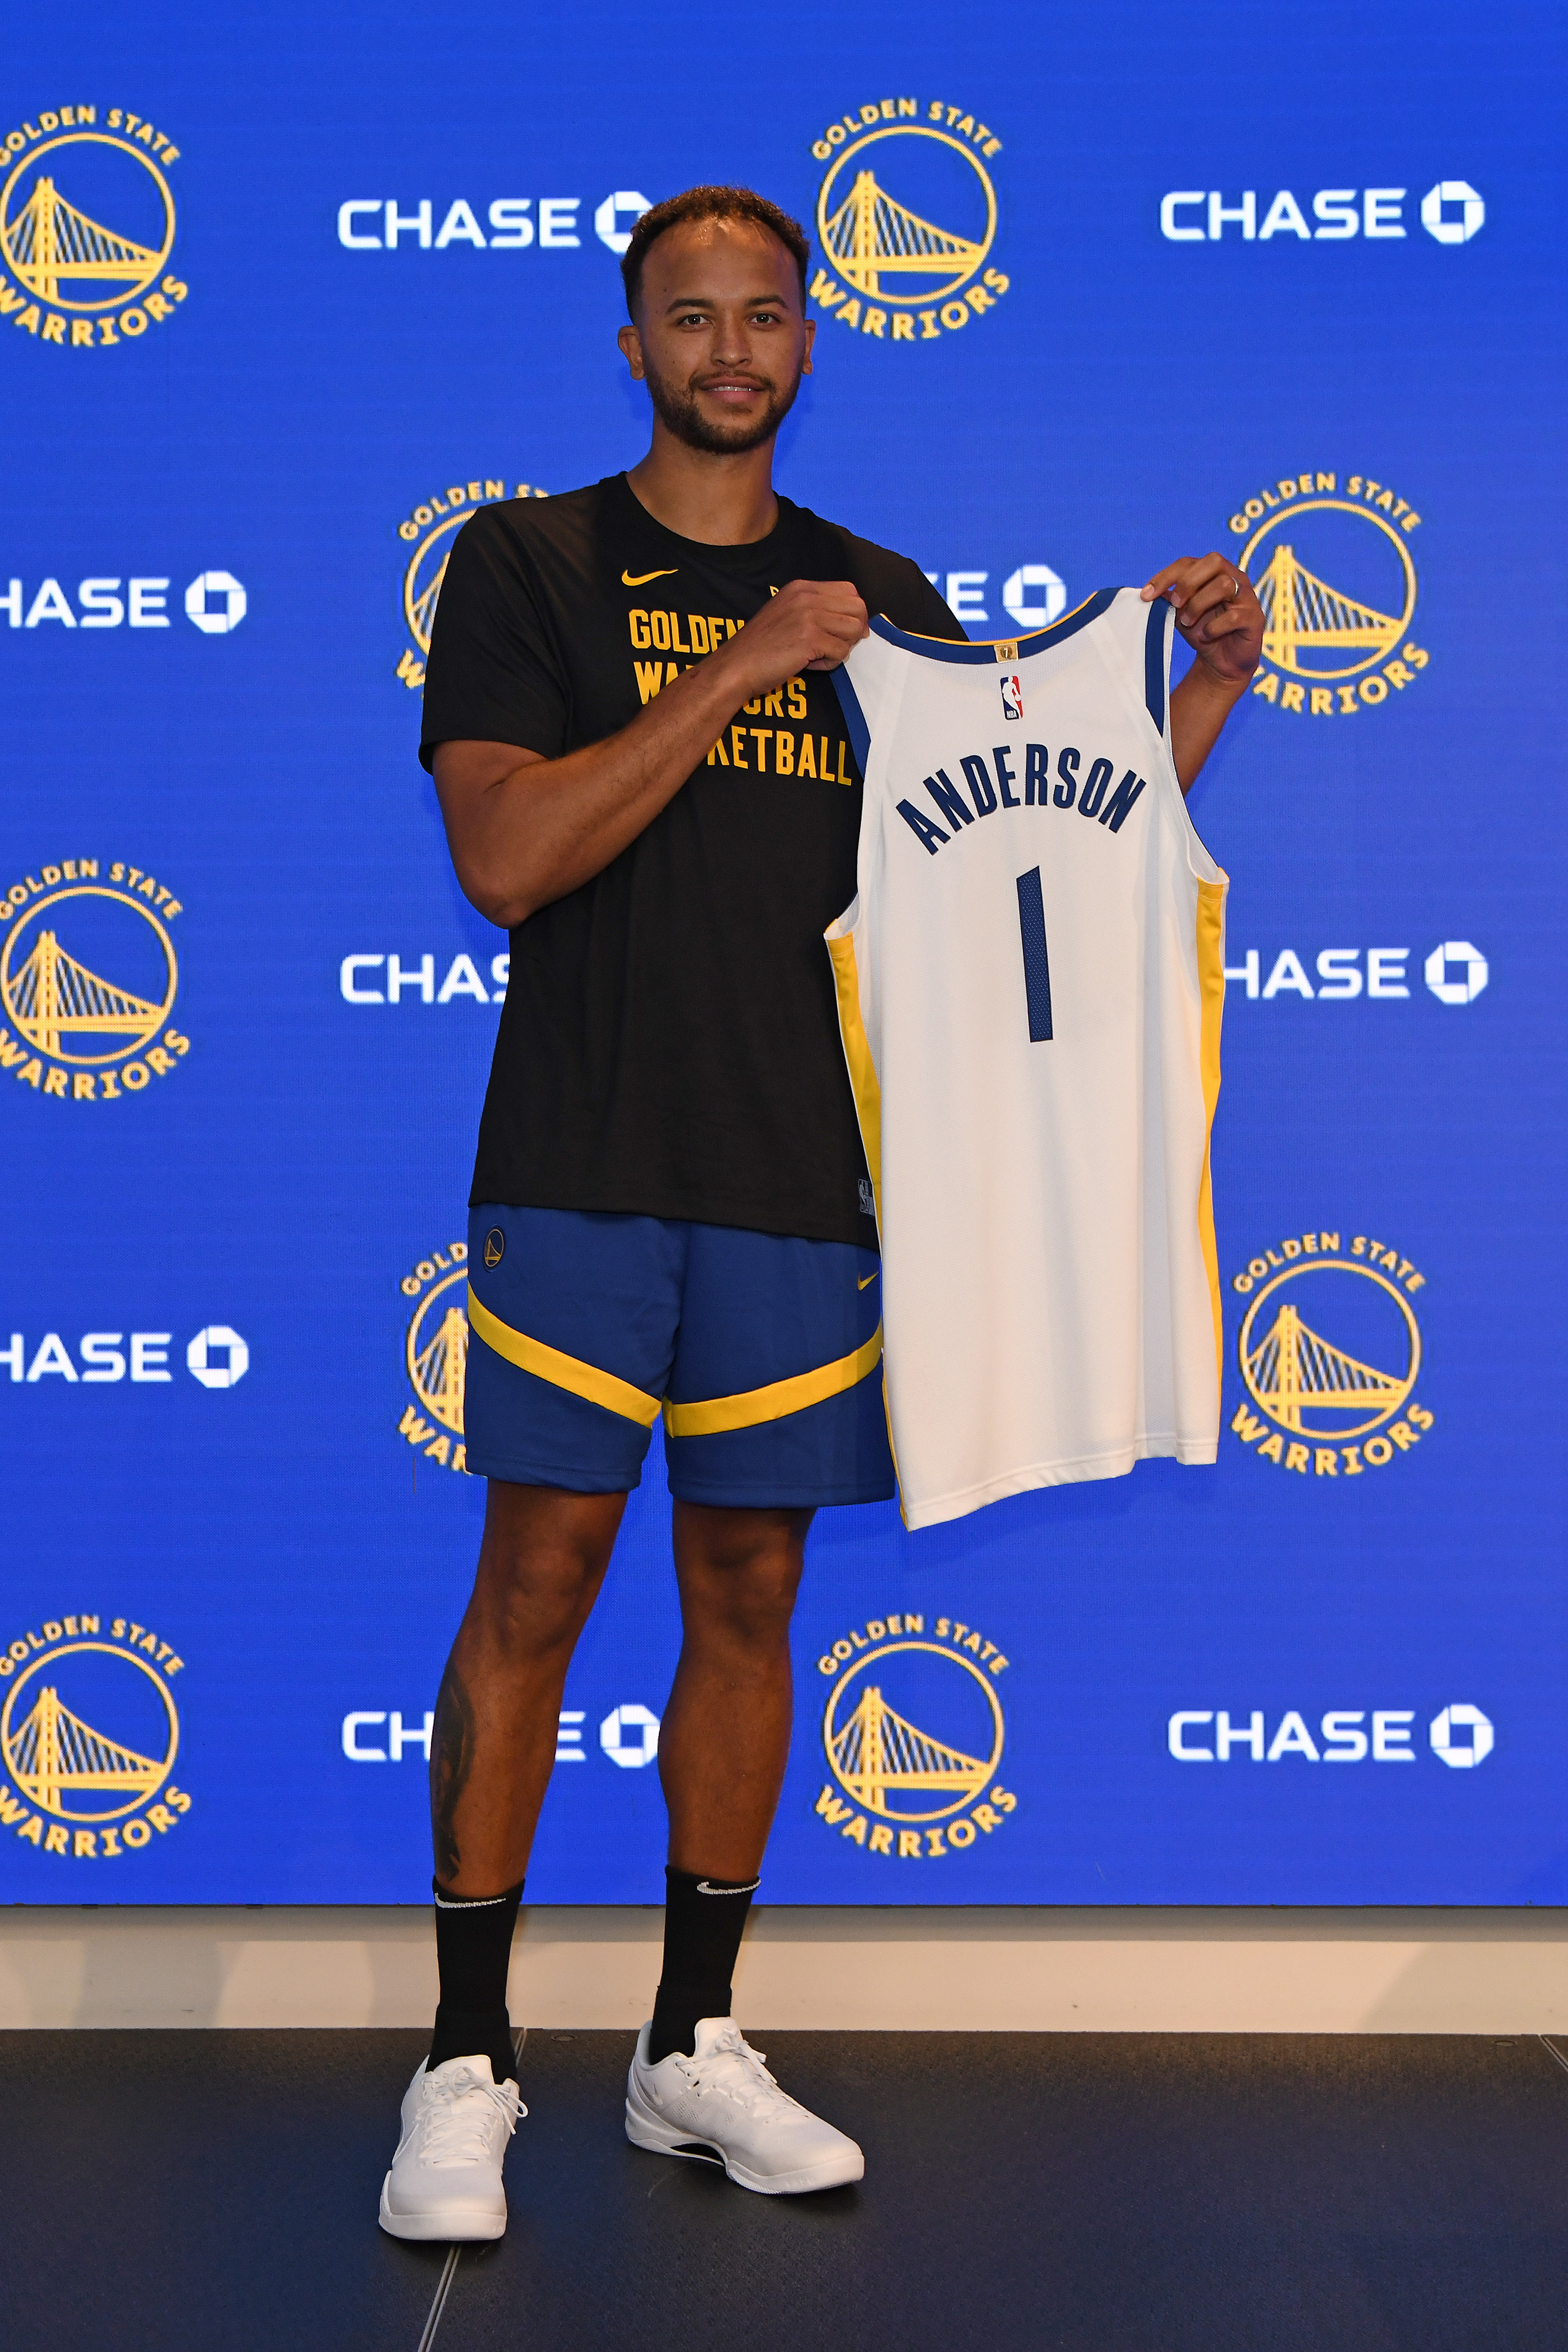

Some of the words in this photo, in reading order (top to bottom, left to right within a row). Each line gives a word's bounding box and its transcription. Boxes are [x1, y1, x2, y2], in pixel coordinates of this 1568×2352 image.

[0, 106, 95, 166] GOLDEN
[108, 109, 180, 165] STATE
[812, 98, 917, 159] GOLDEN
[929, 101, 1002, 157] STATE
[338, 198, 580, 248] CHASE
[1161, 188, 1406, 240] CHASE
[0, 275, 188, 347] WARRIORS
[809, 268, 1010, 341] WARRIORS
[399, 479, 504, 540] GOLDEN
[1229, 472, 1336, 533] GOLDEN
[1347, 475, 1421, 532] STATE
[1253, 642, 1429, 716] ARRIORS
[1006, 710, 1017, 719] NBA
[707, 725, 852, 786] KETBALL
[896, 743, 1147, 856] ANDERSON
[0, 860, 98, 920] GOLDEN
[110, 862, 183, 919] STATE
[1016, 865, 1053, 1043] 1
[1223, 948, 1410, 998] HASE
[0, 1028, 190, 1100] WARRIORS
[401, 1242, 468, 1296] GOLD
[1233, 1232, 1340, 1293] GOLDEN
[1351, 1236, 1425, 1292] STATE
[0, 1332, 172, 1382] HASE
[1231, 1404, 1434, 1476] WARRIORS
[0, 1615, 99, 1676] GOLDEN
[111, 1619, 184, 1675] STATE
[818, 1614, 923, 1675] GOLDEN
[936, 1618, 1009, 1674] STATE
[1168, 1711, 1415, 1761] CHASE
[0, 1786, 192, 1858] WARRIORS
[816, 1785, 1017, 1857] WARRIORS
